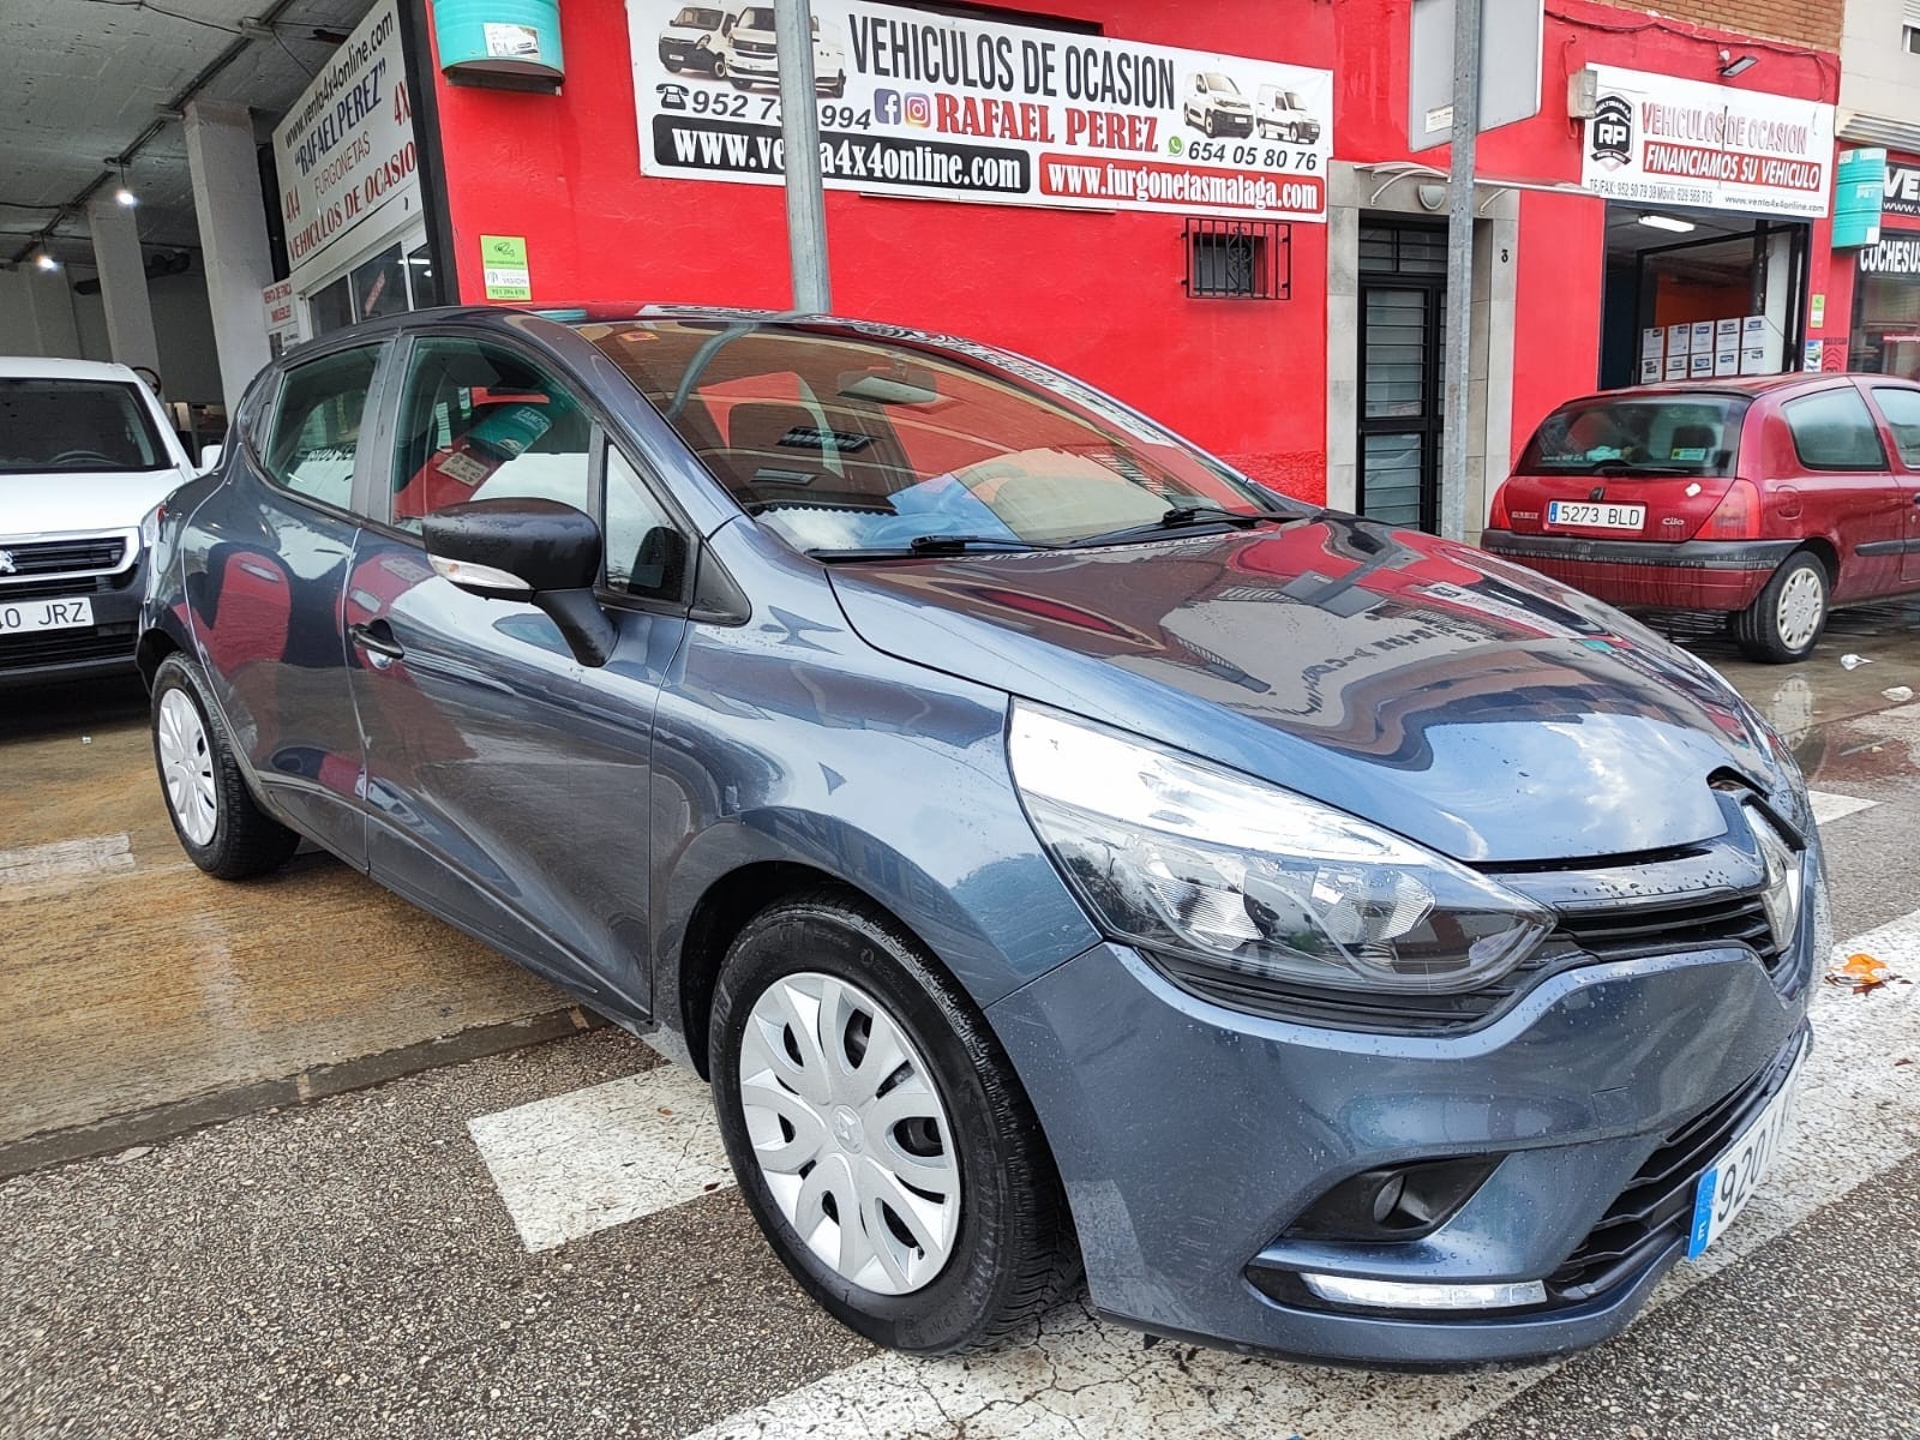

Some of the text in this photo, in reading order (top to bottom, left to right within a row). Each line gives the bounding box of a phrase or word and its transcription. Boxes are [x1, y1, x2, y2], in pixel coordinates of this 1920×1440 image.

[848, 14, 1175, 110] VEHICULOS DE OCASION
[395, 82, 412, 126] 4X
[691, 90, 749, 119] 952
[935, 93, 1159, 153] RAFAEL PEREZ
[1599, 123, 1627, 145] RP
[1642, 102, 1724, 143] VEHICULOS
[1727, 115, 1746, 147] DE
[1748, 119, 1808, 154] OCASION
[315, 130, 371, 199] FURGONETAS
[672, 128, 1021, 189] www.vea4x4online.com
[1188, 141, 1318, 172] 654 05 80 76
[1645, 145, 1820, 190] FINANCIAMOS SU VEHICULO
[286, 184, 301, 223] 4X4
[289, 141, 416, 261] VEHICULOS DE OCASIO
[1048, 162, 1318, 210] www.furgonetasmalaga.com
[1884, 166, 1920, 201] VE
[1860, 239, 1920, 273] COCHESU
[1561, 505, 1640, 527] 5273 BLD
[1662, 516, 1685, 526] Clio
[0, 602, 87, 629] 0 JRZ
